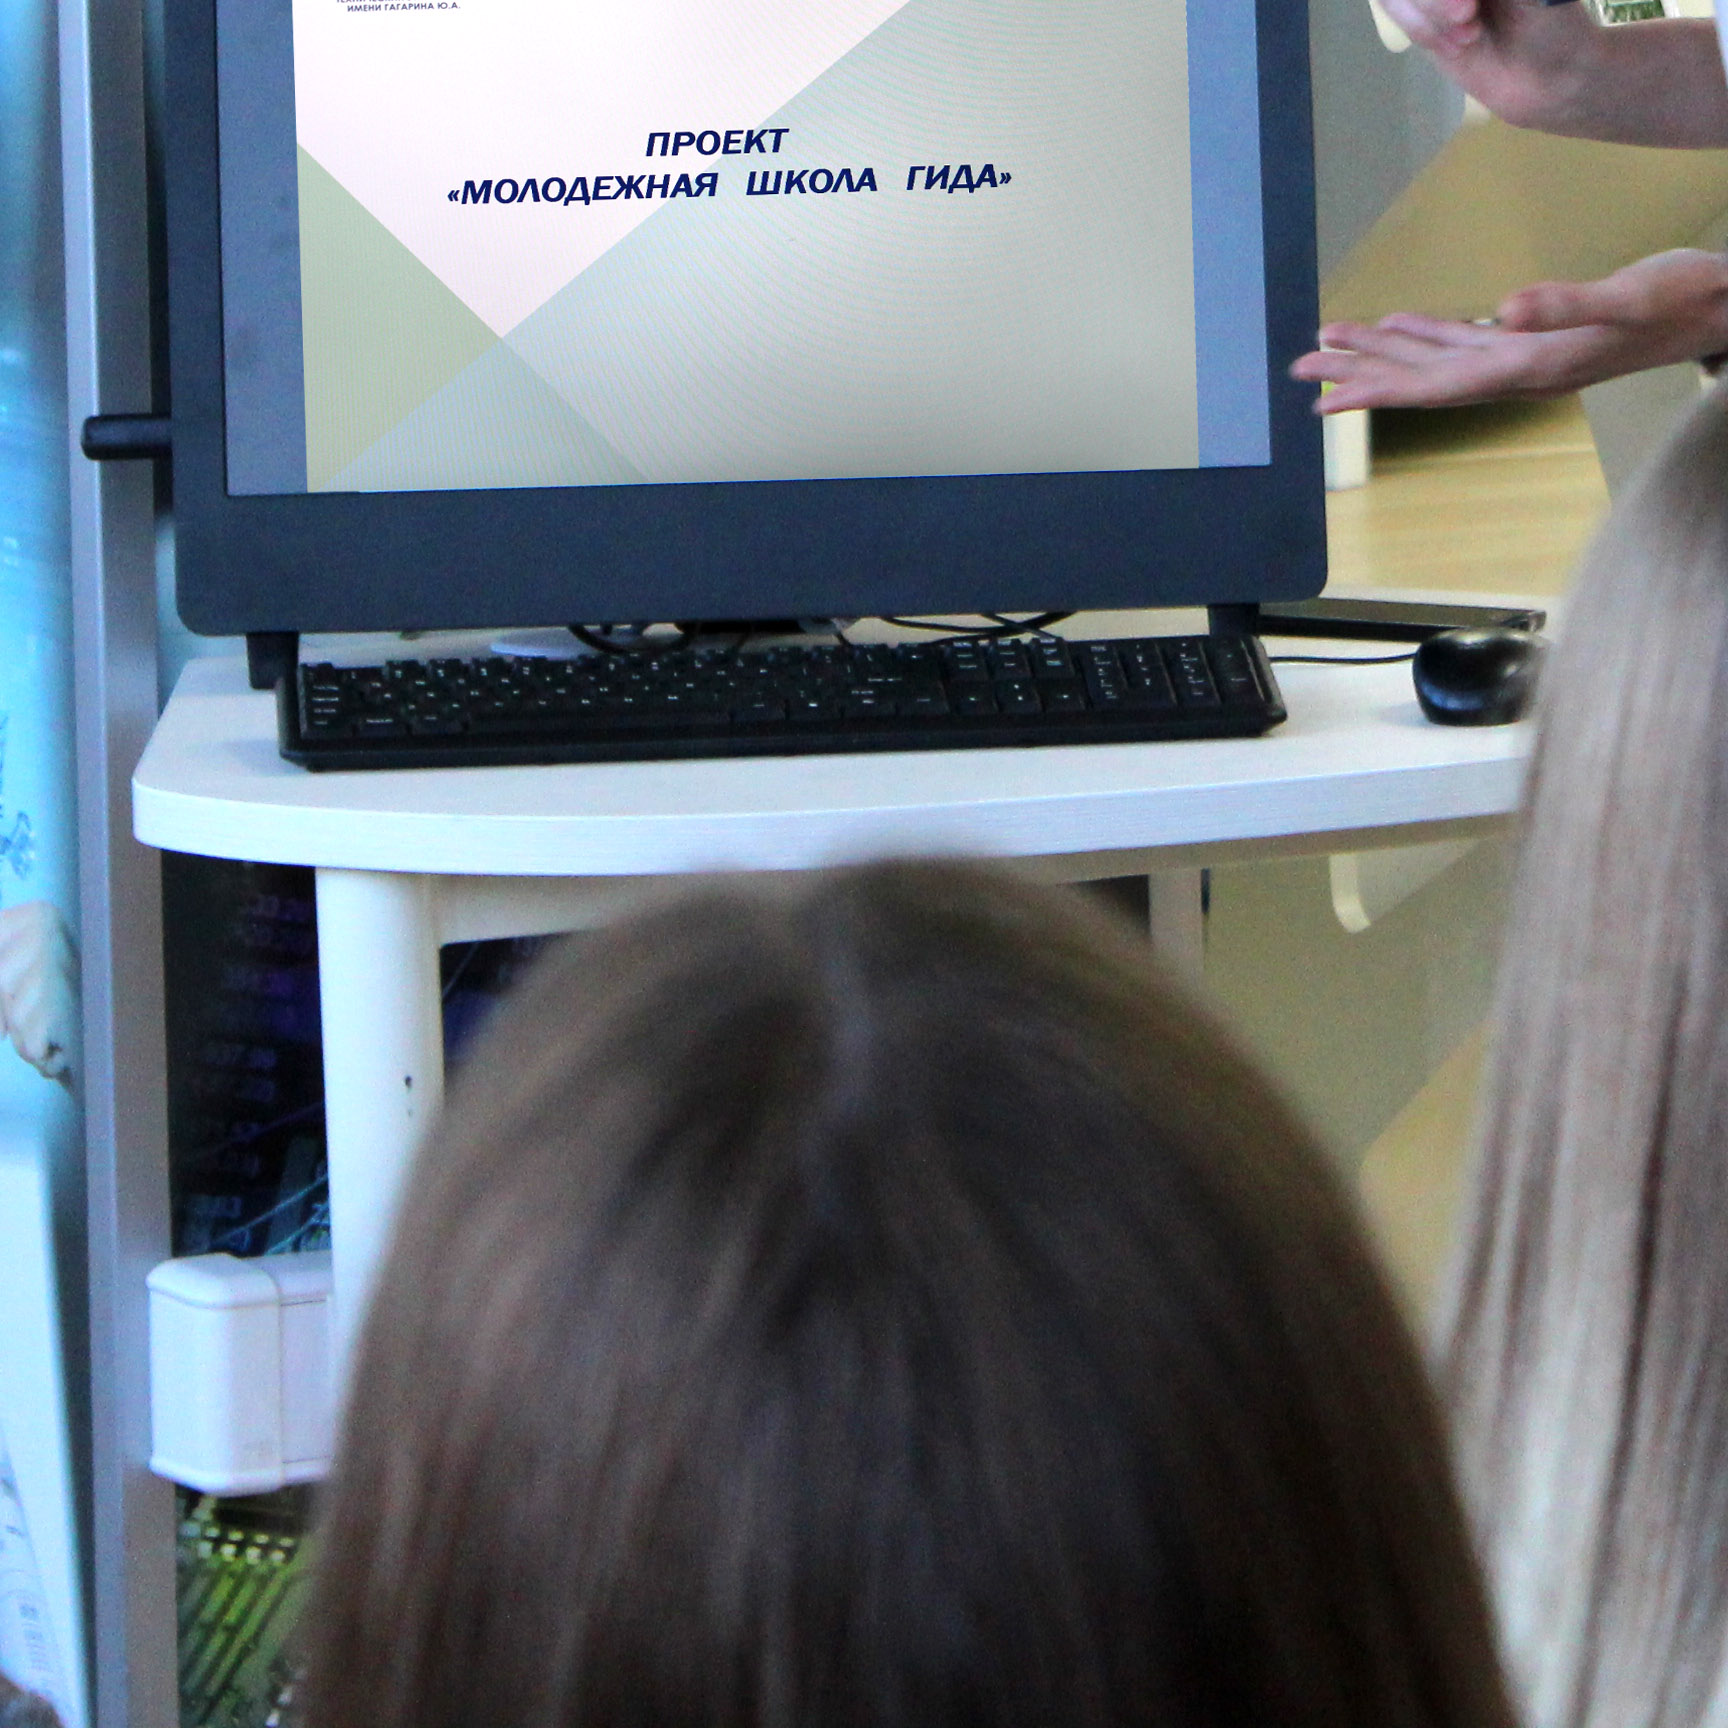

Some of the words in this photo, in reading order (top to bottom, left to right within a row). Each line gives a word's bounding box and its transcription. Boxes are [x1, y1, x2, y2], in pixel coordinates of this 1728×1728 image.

[347, 4, 382, 13] ИМЕНИ
[384, 2, 435, 12] ГАГАРИНА
[645, 128, 790, 158] ПРОЕКТ
[447, 173, 718, 207] «МОЛОДЕЖНАЯ
[746, 167, 877, 197] ШКОЛА
[906, 163, 1013, 195] ГИДА»
